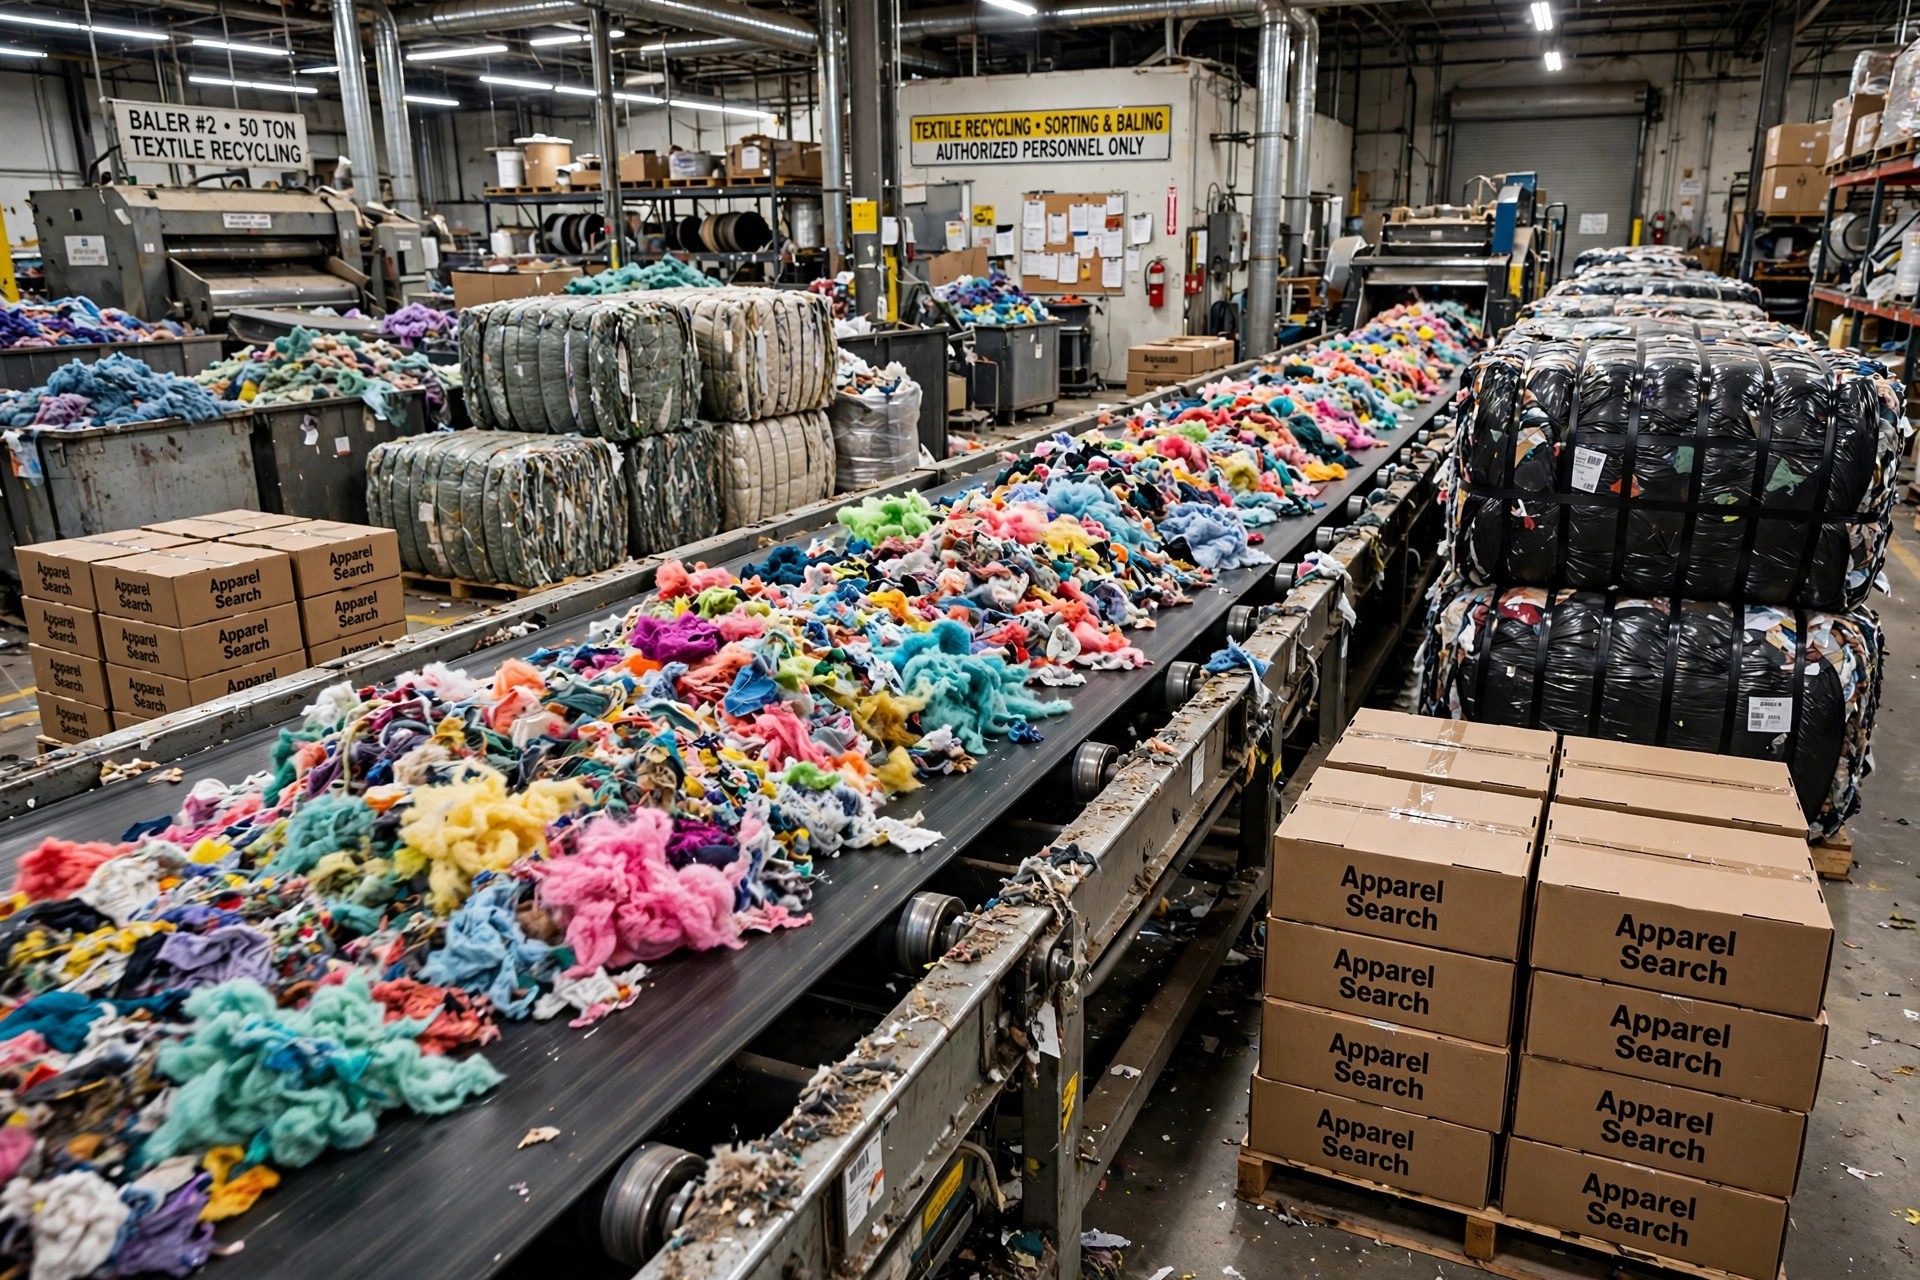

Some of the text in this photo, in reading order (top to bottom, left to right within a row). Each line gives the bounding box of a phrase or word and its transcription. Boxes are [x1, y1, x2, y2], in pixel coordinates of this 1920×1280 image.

[128, 109, 296, 140] BALER #2 50 TON
[915, 111, 1163, 140] TEXTILE RECYCLING SORTING & BALING
[129, 135, 301, 163] TEXTILE RECYCLING
[936, 136, 1145, 161] AUTHORIZED PERSONNEL ONLY
[329, 544, 373, 567] Apparel
[37, 561, 71, 580] Apparel
[209, 568, 261, 594] Apparel
[333, 560, 374, 581] Search
[41, 578, 73, 596] Search
[114, 577, 151, 597] Apparel
[215, 587, 262, 609] Search
[119, 594, 153, 613] Search
[335, 590, 378, 614] Apparel
[43, 610, 76, 630] Apparel
[338, 607, 379, 629] Search
[47, 626, 78, 645] Search
[122, 628, 158, 648] Apparel
[218, 618, 269, 645] Apparel
[127, 645, 160, 664] Search
[223, 636, 270, 660] Search
[50, 658, 82, 678] Apparel
[227, 667, 277, 695] Apparel
[54, 673, 84, 693] Search
[129, 677, 165, 697] Apparel
[56, 704, 88, 725] Apparel
[133, 694, 168, 714] Search
[60, 720, 90, 740] Search
[1340, 864, 1444, 904] Apparel
[1345, 893, 1438, 932] Search
[1614, 913, 1737, 957] Apparel
[1333, 947, 1435, 989] Apparel
[1619, 944, 1728, 987] Search
[1338, 976, 1429, 1015] Search
[1609, 1004, 1732, 1049] Apparel
[1328, 1032, 1430, 1075] Apparel
[1614, 1034, 1722, 1078] Search
[1333, 1059, 1424, 1101] Search
[1595, 1089, 1714, 1137] Apparel
[1316, 1108, 1415, 1152] Apparel
[1600, 1118, 1706, 1165] Search
[1321, 1134, 1409, 1177] Search
[1581, 1171, 1697, 1222] Apparel
[1585, 1201, 1689, 1248] Search
